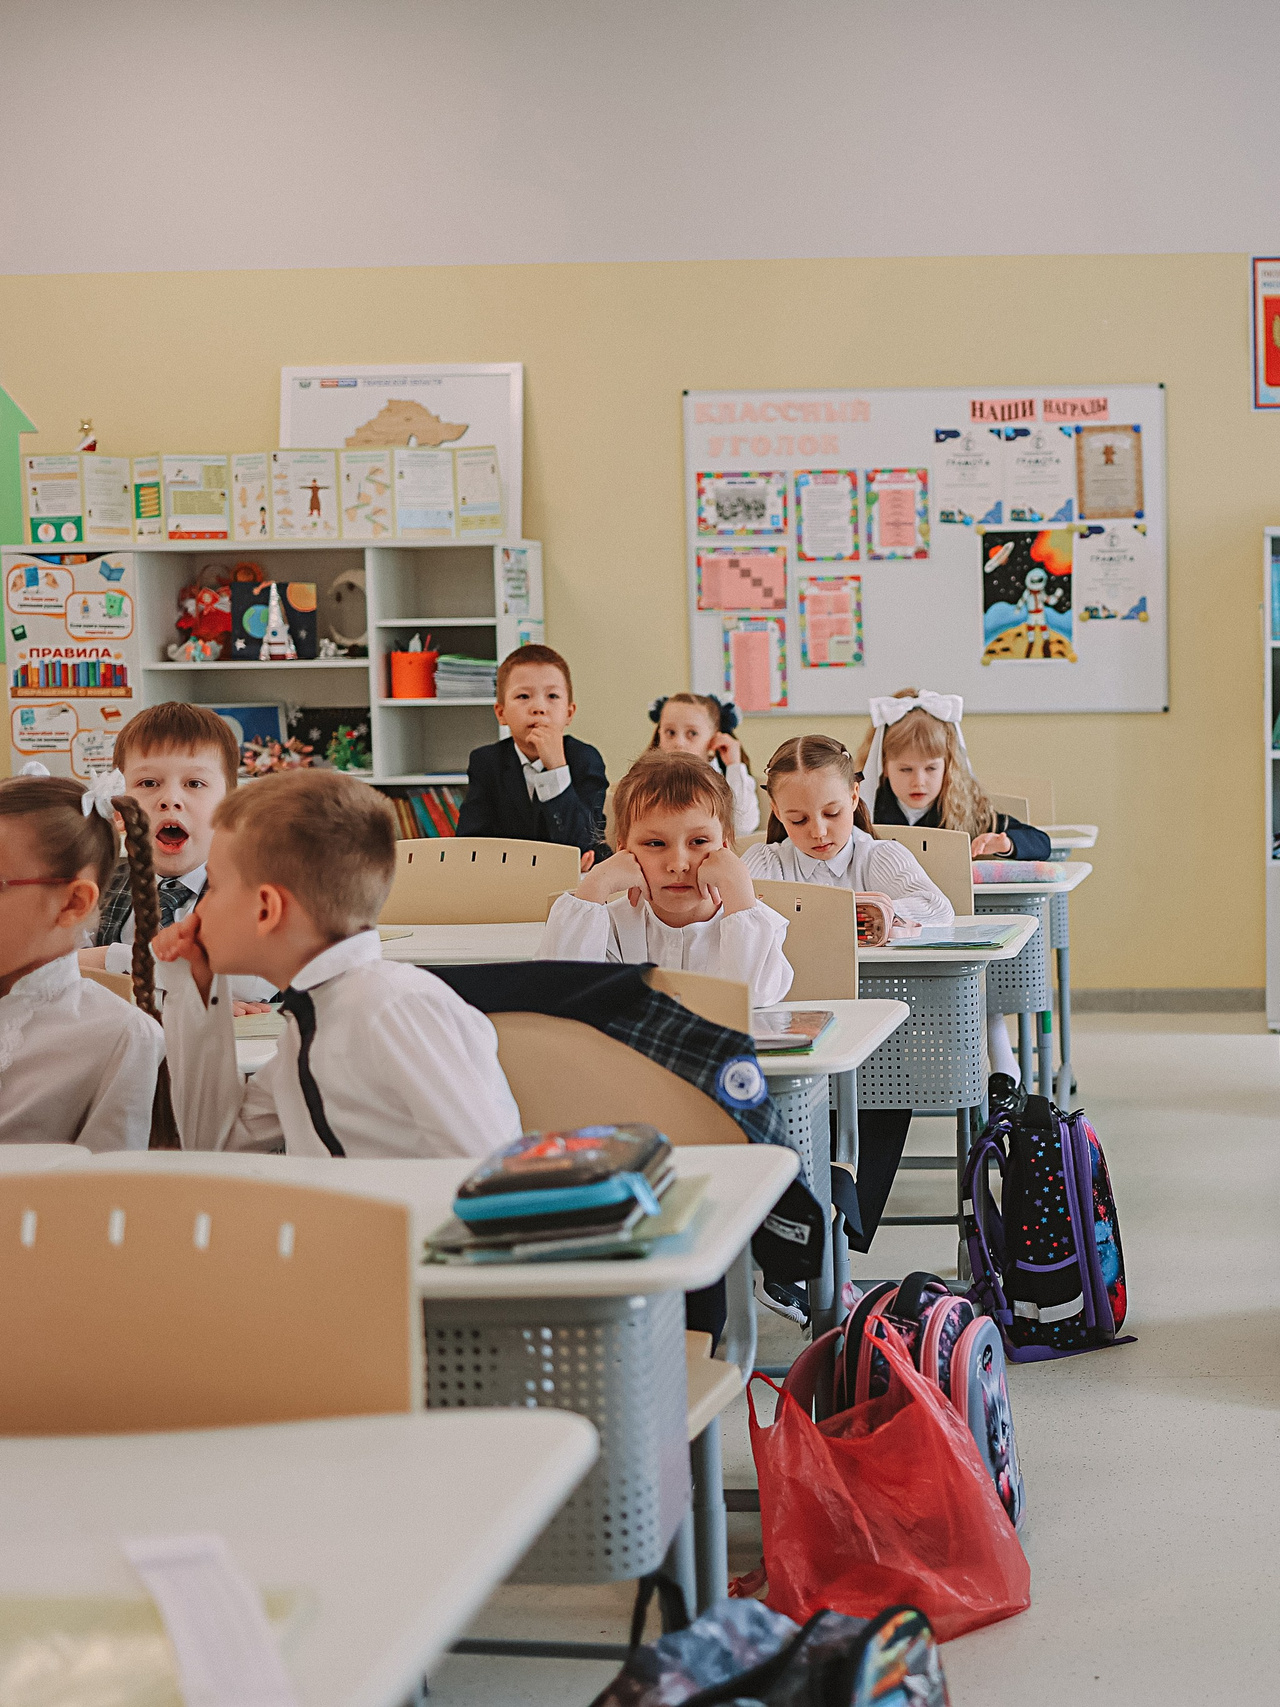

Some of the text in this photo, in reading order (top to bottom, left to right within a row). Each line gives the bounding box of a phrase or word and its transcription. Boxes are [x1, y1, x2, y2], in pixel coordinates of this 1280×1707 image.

[694, 398, 872, 424] КЛАССНЫЙ
[970, 397, 1108, 422] НАШИ НАГРАДЫ
[707, 434, 839, 458] УГОЛОК
[28, 648, 112, 659] ПРАВИЛА
